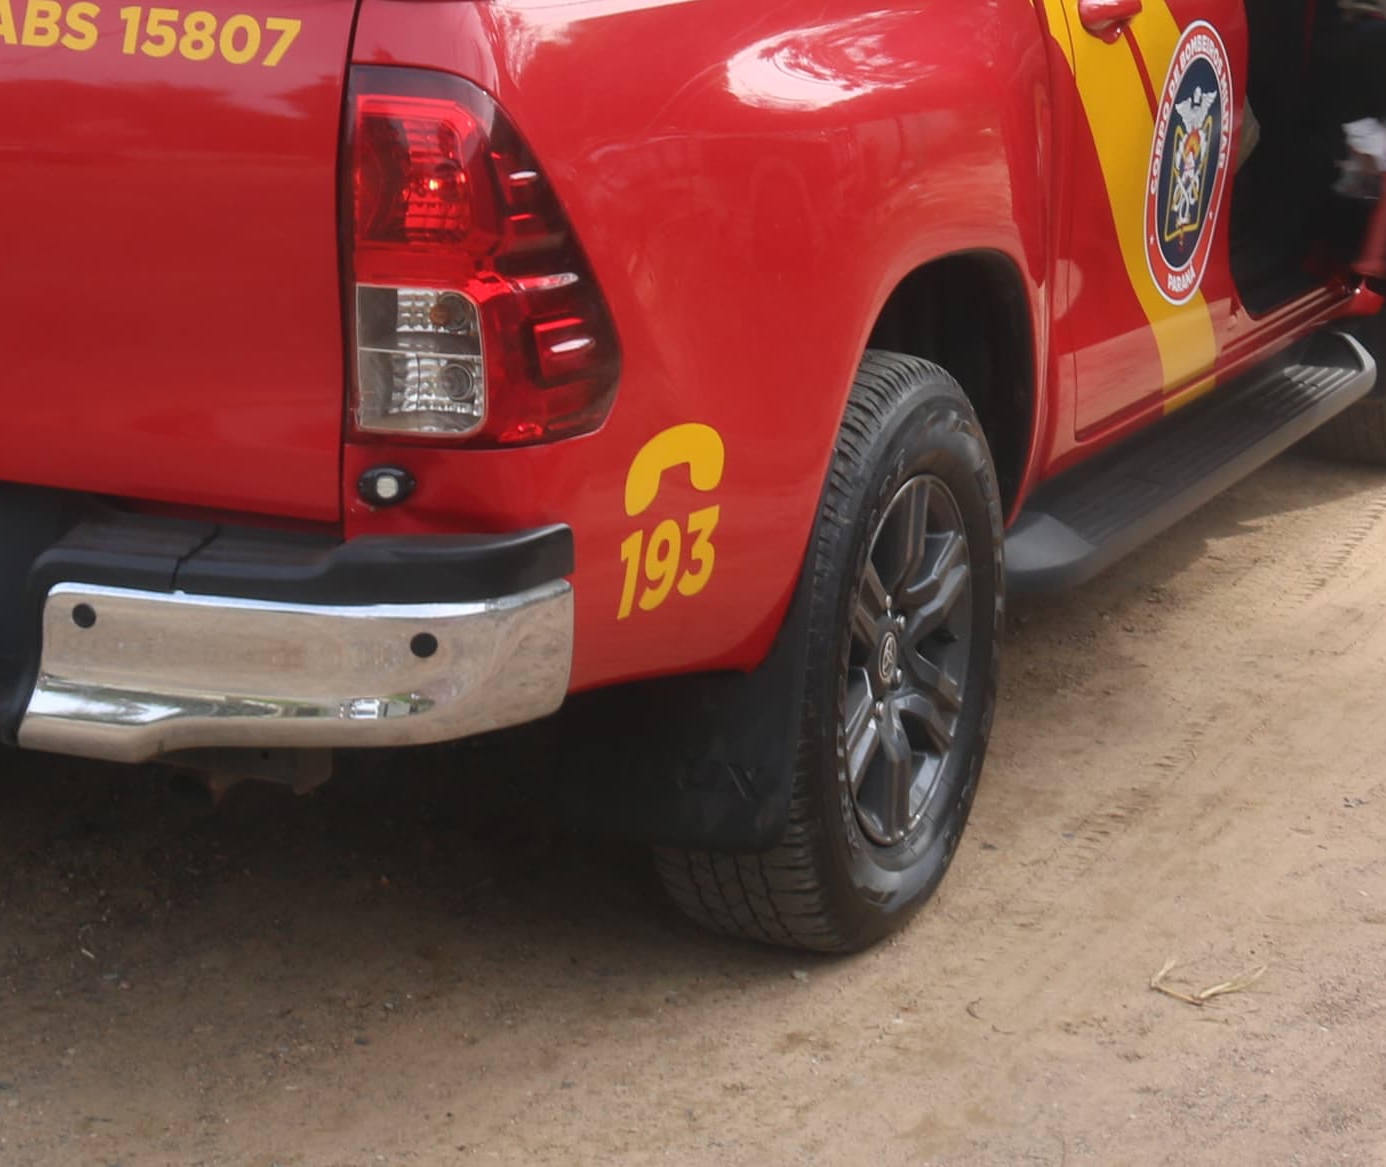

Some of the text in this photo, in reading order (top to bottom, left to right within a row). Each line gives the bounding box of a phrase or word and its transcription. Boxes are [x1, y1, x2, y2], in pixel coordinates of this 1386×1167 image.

[119, 5, 302, 68] 15807
[1149, 103, 1171, 195] CORPO
[1179, 34, 1224, 74] BOMBEIROS
[616, 504, 720, 620] 193
